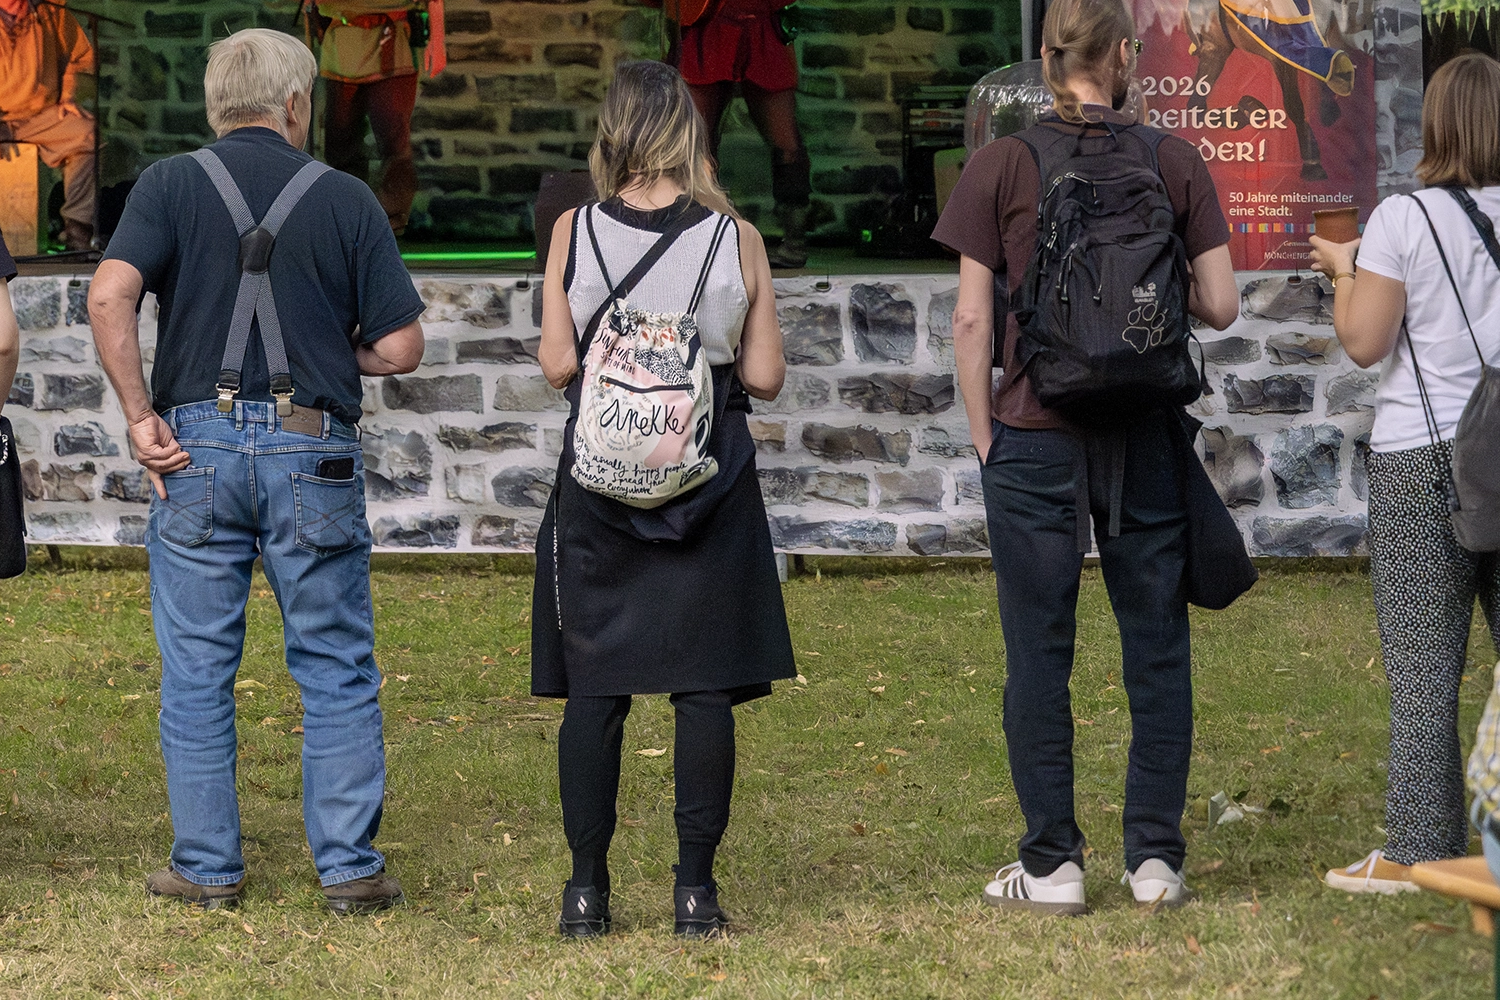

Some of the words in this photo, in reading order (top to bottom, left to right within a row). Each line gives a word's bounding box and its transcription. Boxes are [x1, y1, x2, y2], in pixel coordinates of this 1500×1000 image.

[1142, 75, 1212, 96] 2026
[1228, 191, 1244, 203] 50
[1245, 191, 1278, 203] Jahre
[1281, 191, 1353, 203] miteinander
[1228, 206, 1255, 216] eine
[1257, 205, 1293, 216] Stadt.
